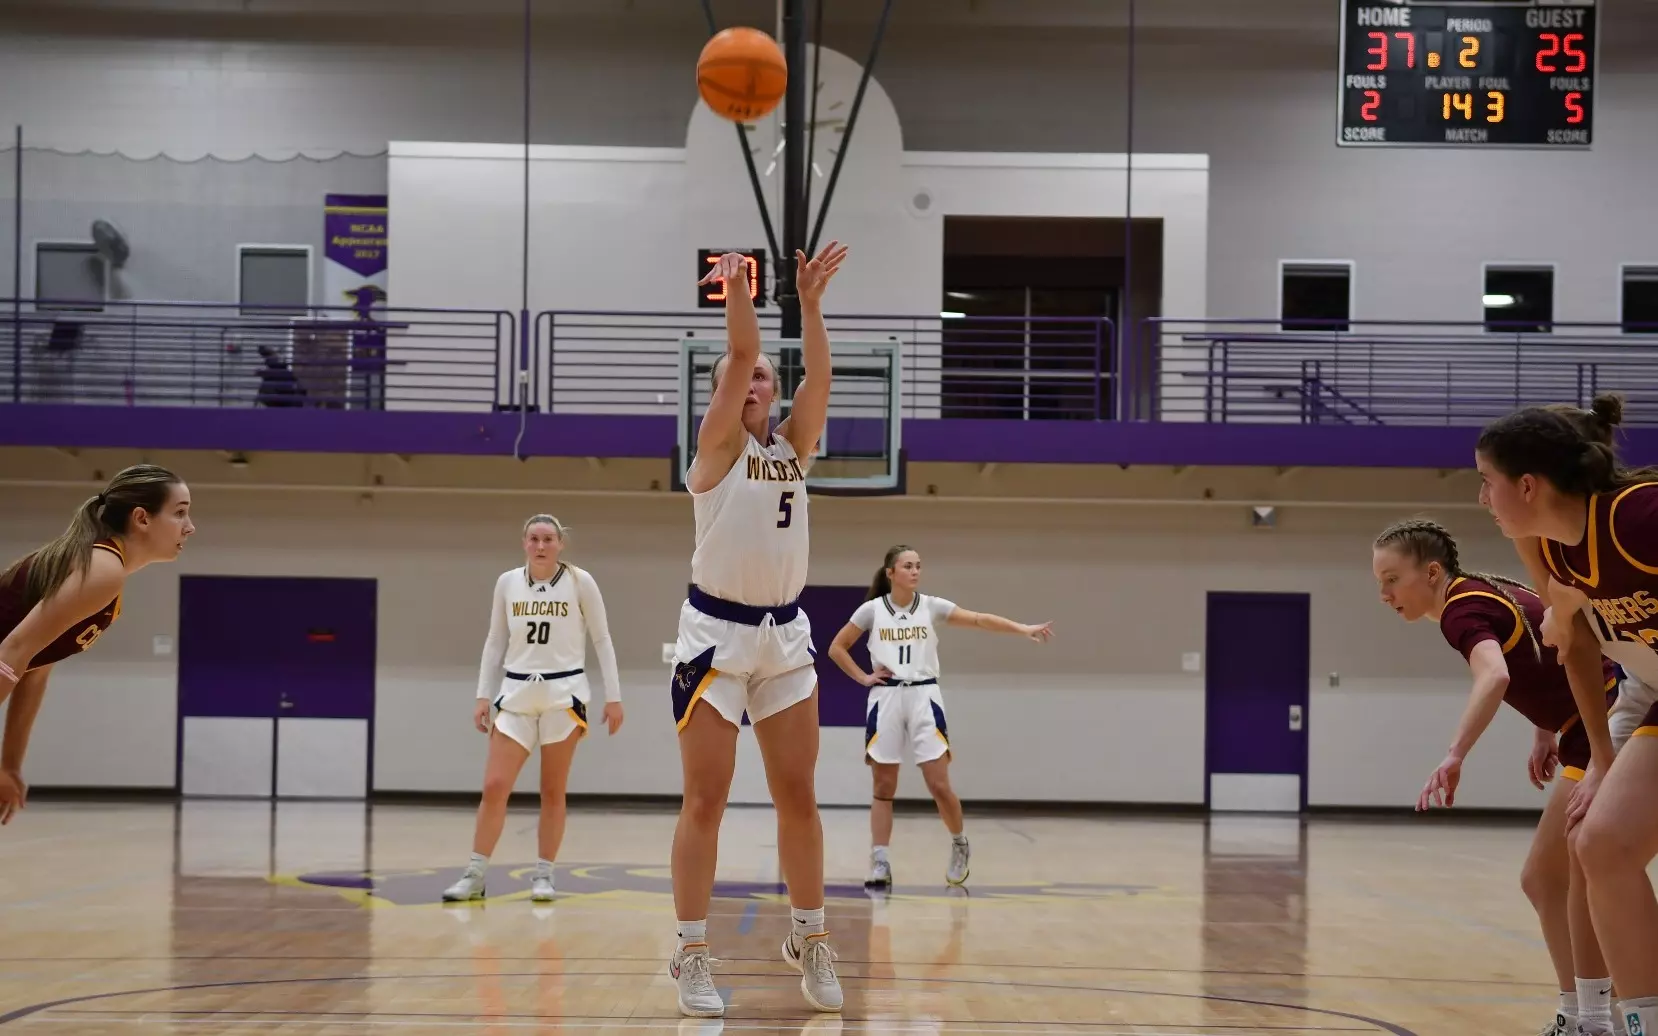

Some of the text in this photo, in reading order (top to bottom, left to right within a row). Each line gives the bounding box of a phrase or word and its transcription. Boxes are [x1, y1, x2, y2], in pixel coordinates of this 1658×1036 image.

[1357, 7, 1411, 26] HOME
[1526, 9, 1585, 27] GUEST
[1447, 19, 1492, 33] PERIOD
[1367, 32, 1415, 71] 37
[1459, 36, 1480, 68] 2
[1535, 33, 1586, 72] 25
[1346, 75, 1387, 88] FOULS
[1424, 77, 1511, 90] PLAYER FOUL
[1550, 77, 1590, 91] FOULS
[1361, 90, 1381, 121] 2
[1442, 91, 1505, 123] 14 3
[1564, 92, 1584, 123] 5
[1344, 127, 1386, 141] SCORE
[1445, 128, 1488, 142] MATCH
[1547, 129, 1588, 143] SCORE
[776, 491, 795, 529] 5
[512, 601, 568, 617] WILDCATS
[526, 621, 551, 645] 20
[879, 626, 928, 641] WILDCATS
[898, 644, 911, 665] 11
